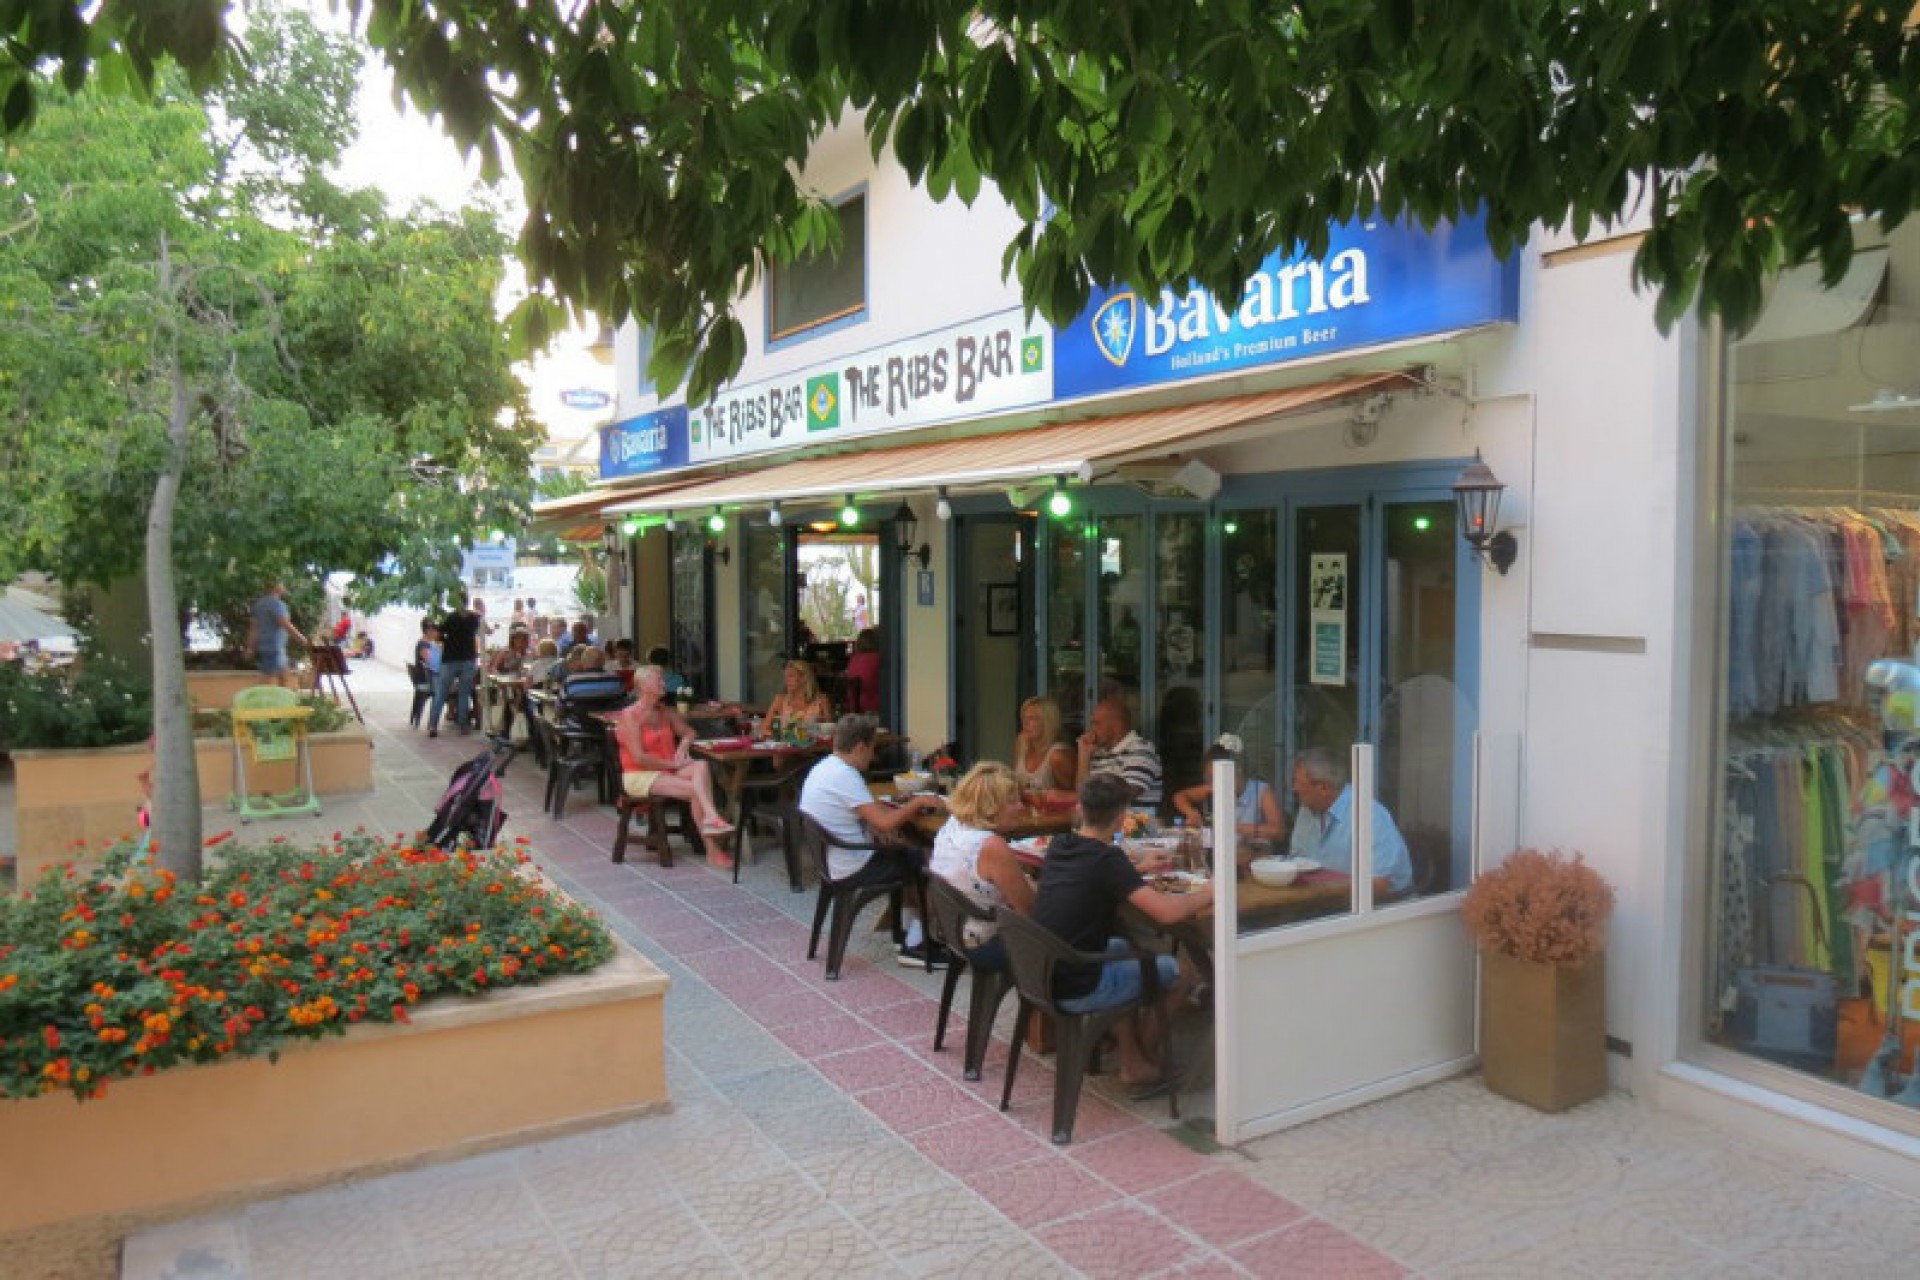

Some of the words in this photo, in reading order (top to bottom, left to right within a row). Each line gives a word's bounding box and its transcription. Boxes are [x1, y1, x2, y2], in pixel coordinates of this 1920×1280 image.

[845, 366, 882, 423] THE
[955, 329, 1014, 403] BAR
[1171, 347, 1230, 370] Holland's
[1234, 335, 1298, 358] Premium
[1303, 326, 1338, 345] Beer
[703, 403, 726, 452] THE
[769, 384, 803, 439] BAR
